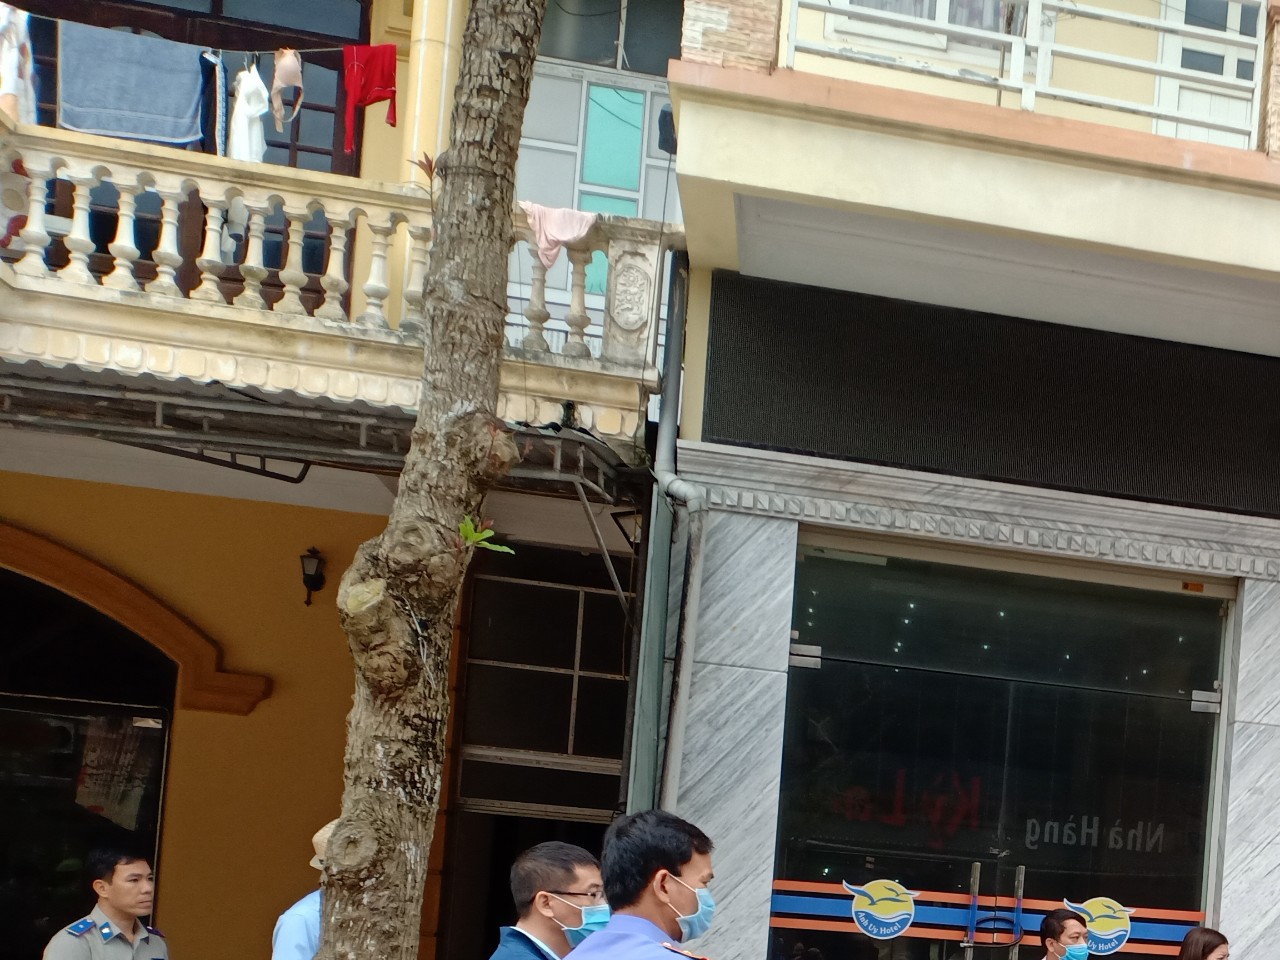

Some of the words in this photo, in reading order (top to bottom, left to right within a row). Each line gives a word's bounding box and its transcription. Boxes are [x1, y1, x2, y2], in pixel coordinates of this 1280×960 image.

[858, 912, 869, 927] Anh
[880, 922, 901, 935] Hotel
[1099, 938, 1119, 951] Hotel
